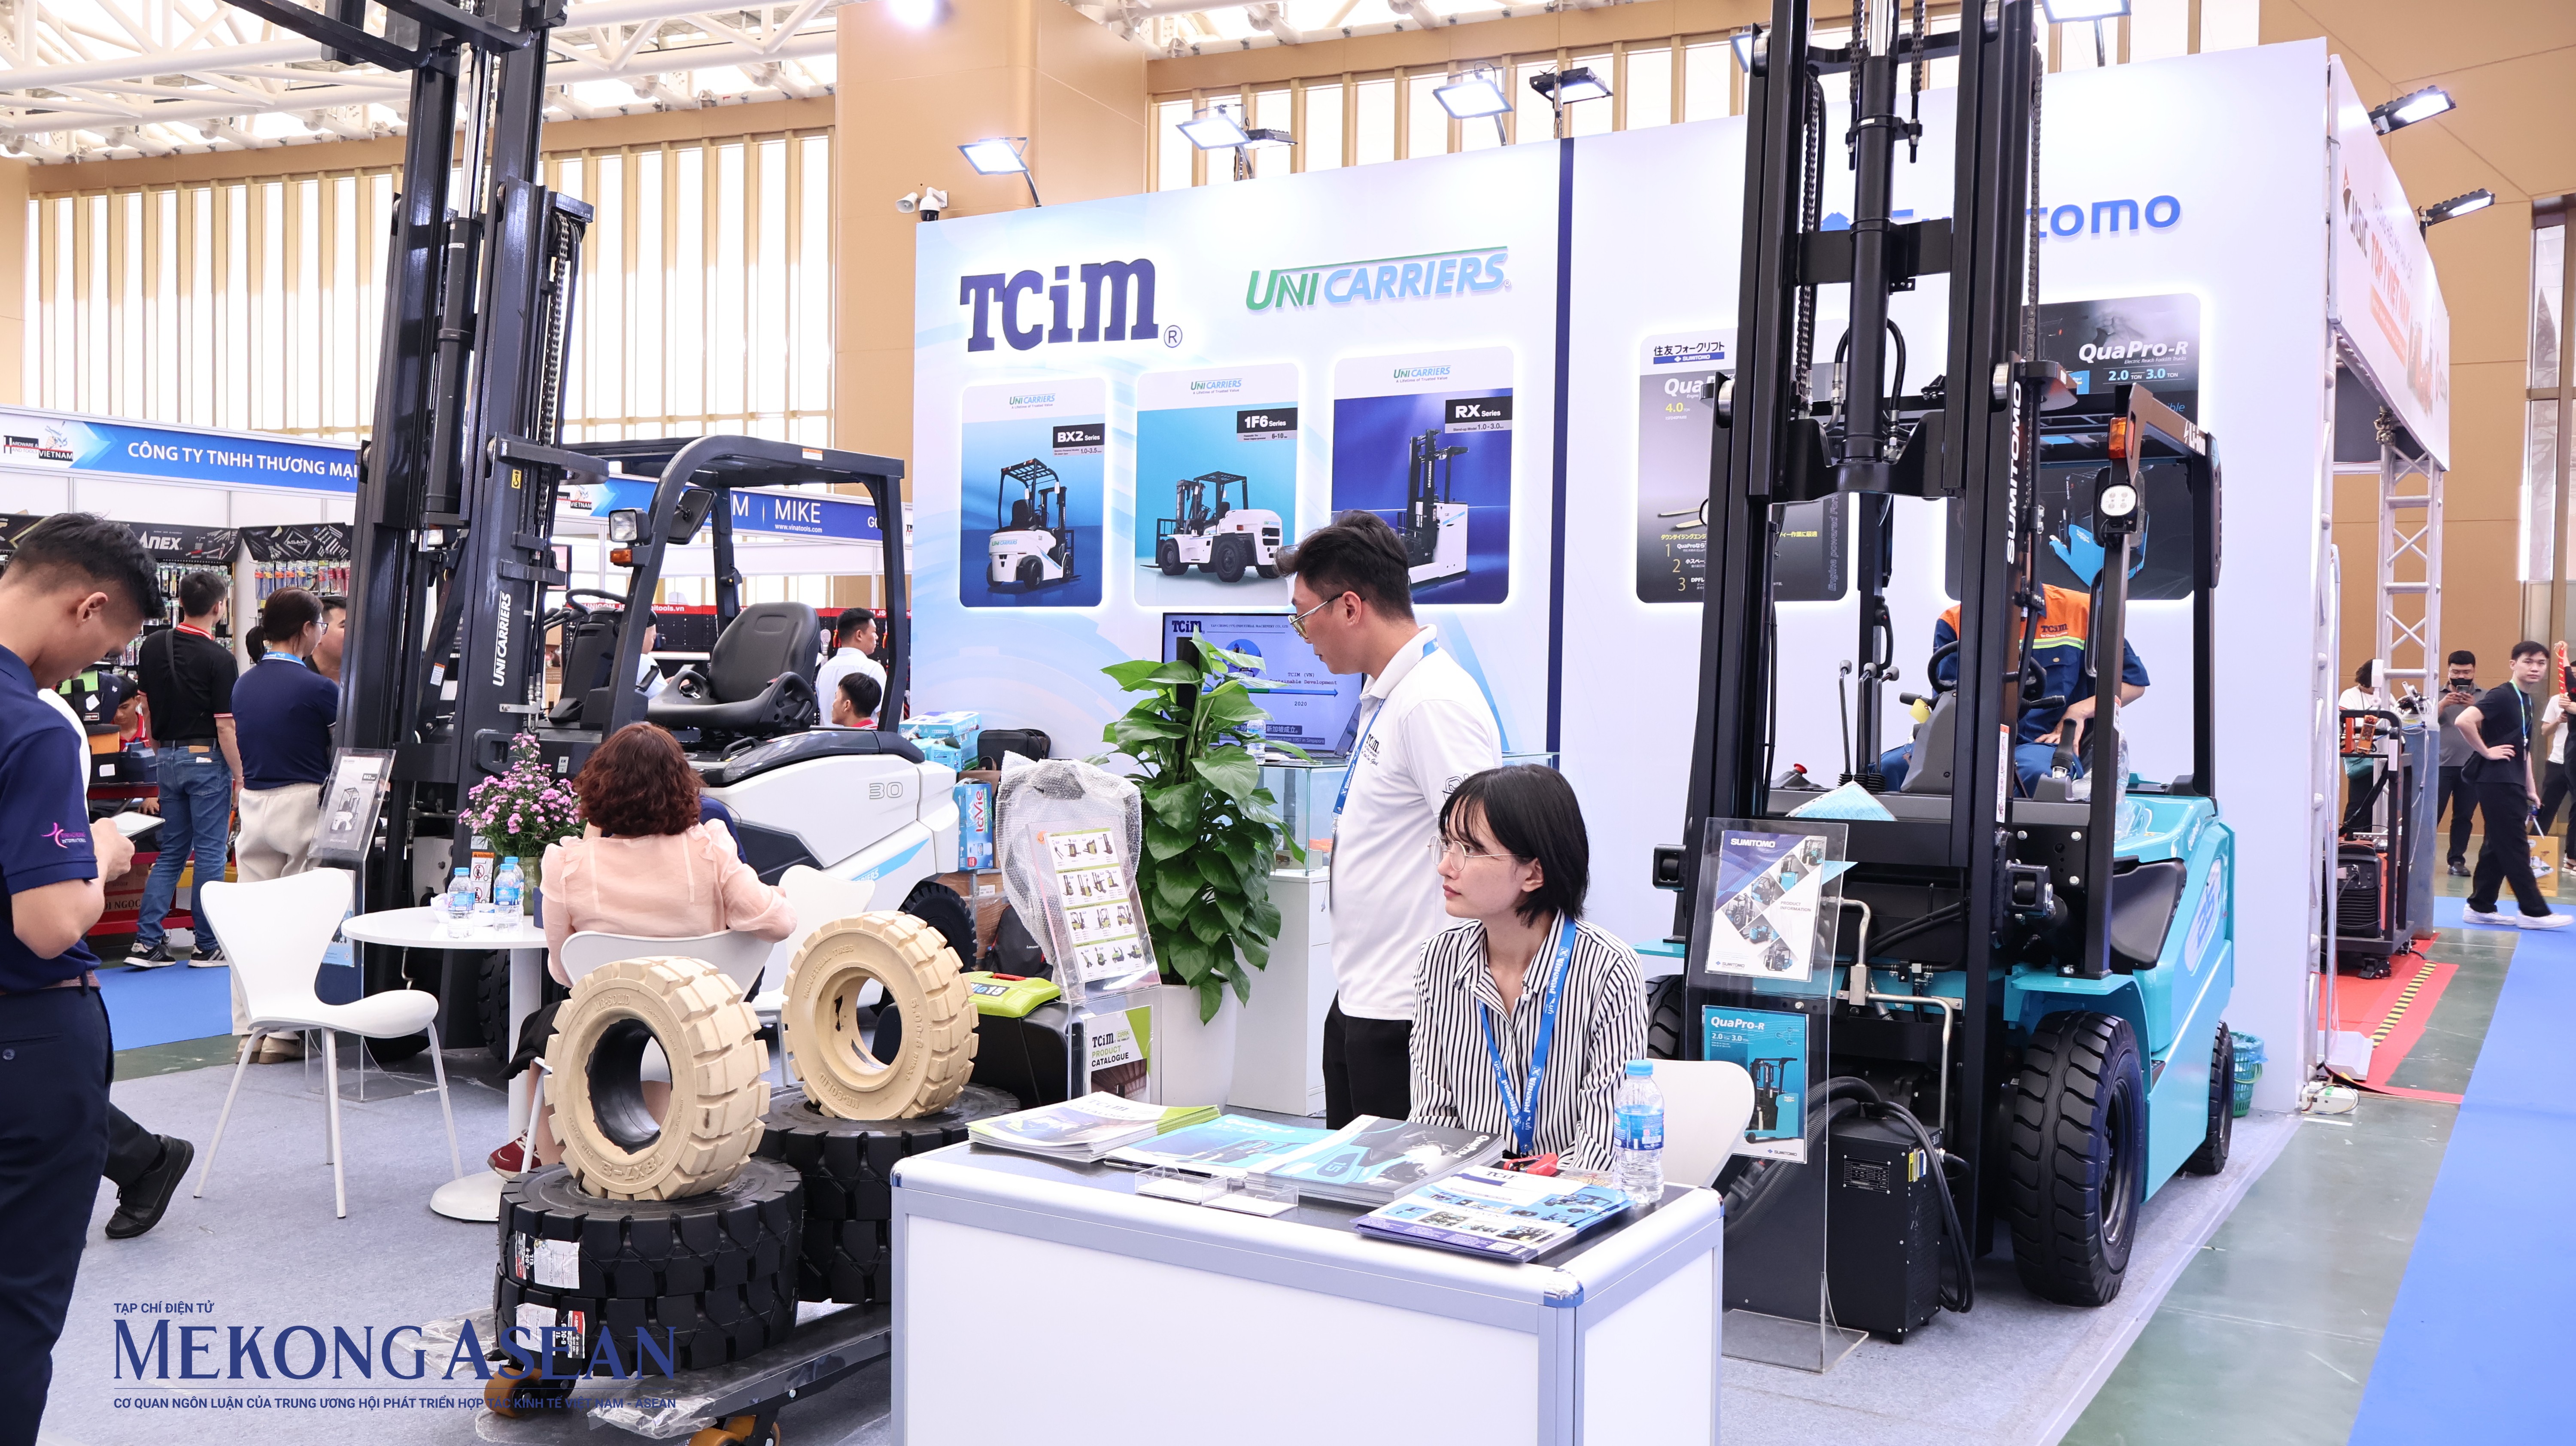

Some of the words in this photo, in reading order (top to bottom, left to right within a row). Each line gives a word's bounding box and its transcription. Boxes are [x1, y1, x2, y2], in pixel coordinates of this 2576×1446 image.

[1654, 342, 1725, 356] 住友フォークリフト
[2079, 340, 2189, 364] QuaPro-R
[2108, 370, 2129, 381] 2.0
[2146, 368, 2166, 379] 3.0
[1455, 404, 1481, 419] RX
[1665, 402, 1683, 413] 4.0
[1244, 415, 1269, 428] 1F6
[1057, 431, 1084, 443] BX2
[39, 450, 73, 460] VIETNAM
[128, 440, 179, 462] CÔNG
[182, 447, 203, 464] TY
[207, 450, 254, 468] TNHH
[257, 454, 325, 475] THƯƠNG
[329, 463, 358, 481] MẠI
[2007, 381, 2022, 565] SUMITOMO
[775, 498, 821, 523] MIKE
[775, 524, 823, 533] www.vinatools.com
[1665, 544, 1670, 557] 1
[1672, 559, 1681, 573] 2
[1678, 577, 1686, 591] 3
[497, 590, 511, 657] CARRIERS
[869, 781, 903, 800] 30
[973, 790, 984, 832] laVie
[1730, 838, 1776, 848] SUMITOMO
[115, 899, 141, 910] NGỌC
[804, 954, 832, 998] INDUSTRIAL
[832, 945, 854, 957] TIRES
[1710, 1016, 1765, 1031] QuaPro-R
[1092, 1045, 1121, 1058] PRODUCT
[1091, 1052, 1129, 1067] CATALOGUE
[1475, 1211, 1504, 1219] EVENT
